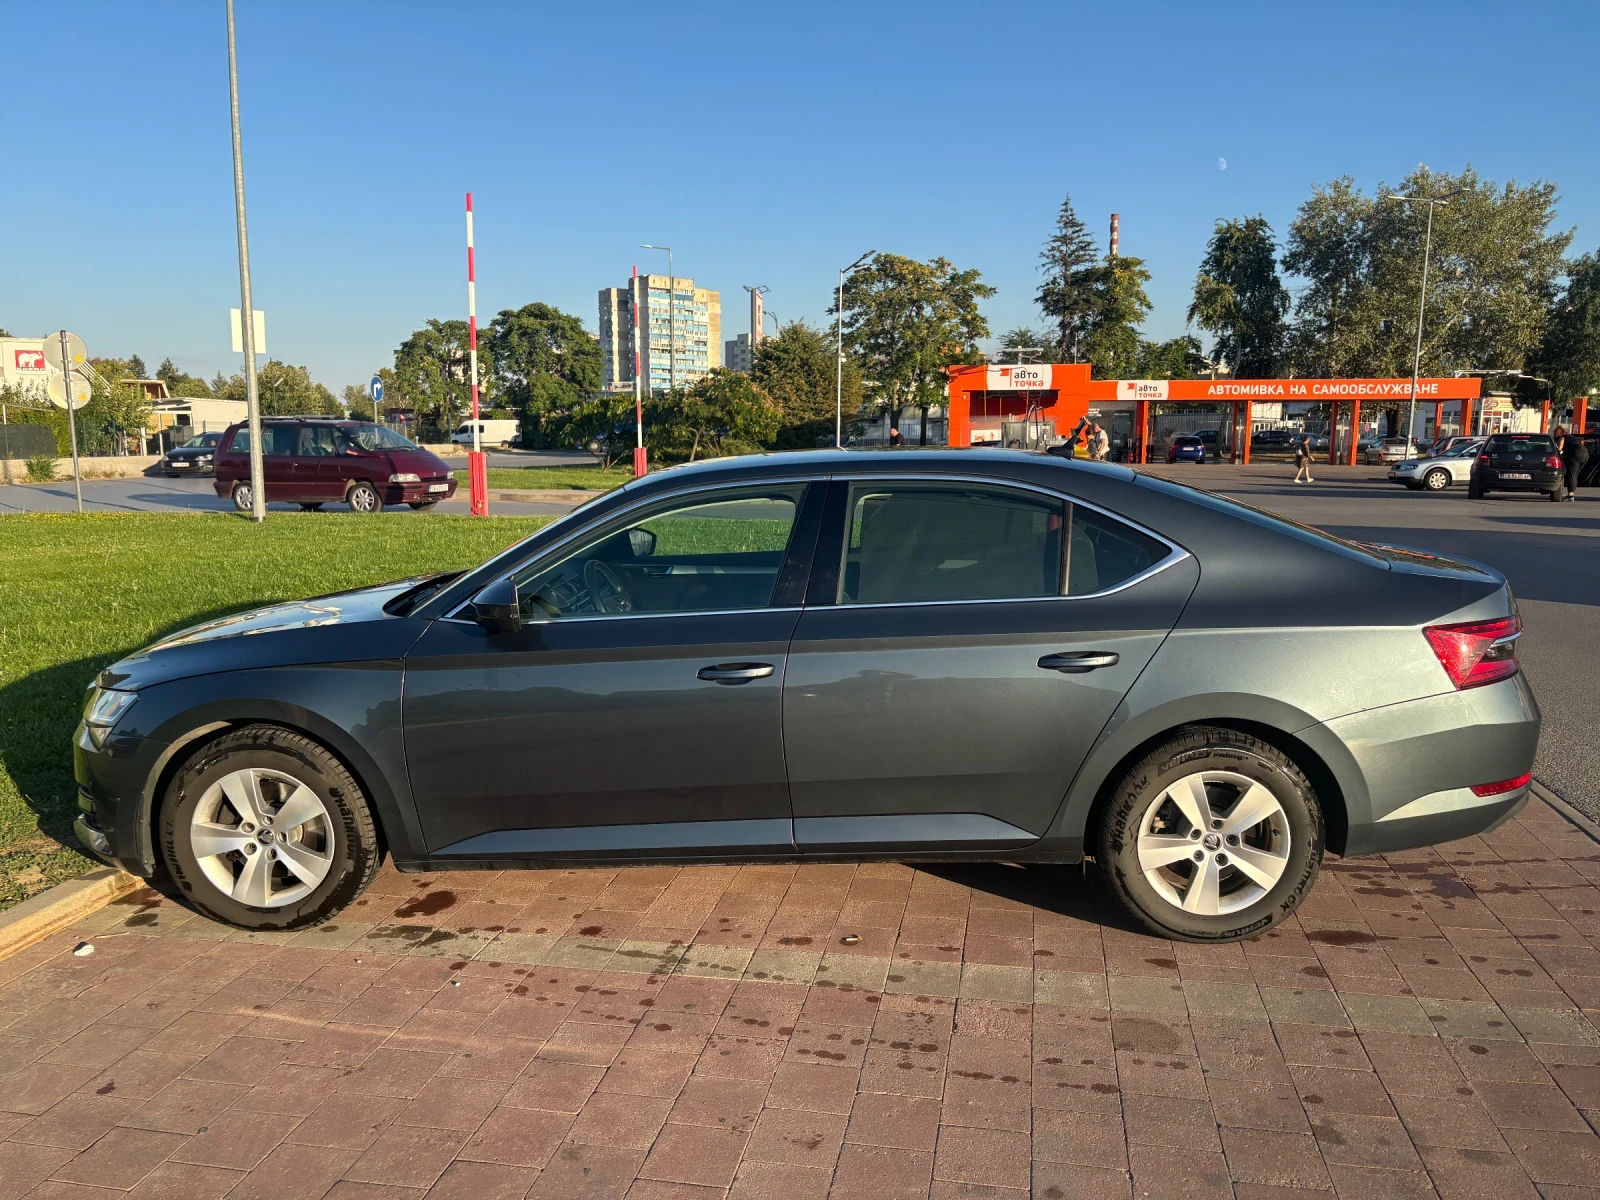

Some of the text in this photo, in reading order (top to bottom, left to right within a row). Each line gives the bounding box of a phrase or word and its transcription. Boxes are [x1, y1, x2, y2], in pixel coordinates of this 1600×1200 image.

[1207, 383, 1439, 395] АВТОМИВКА НА САМООБСЛУЖВАНЕ
